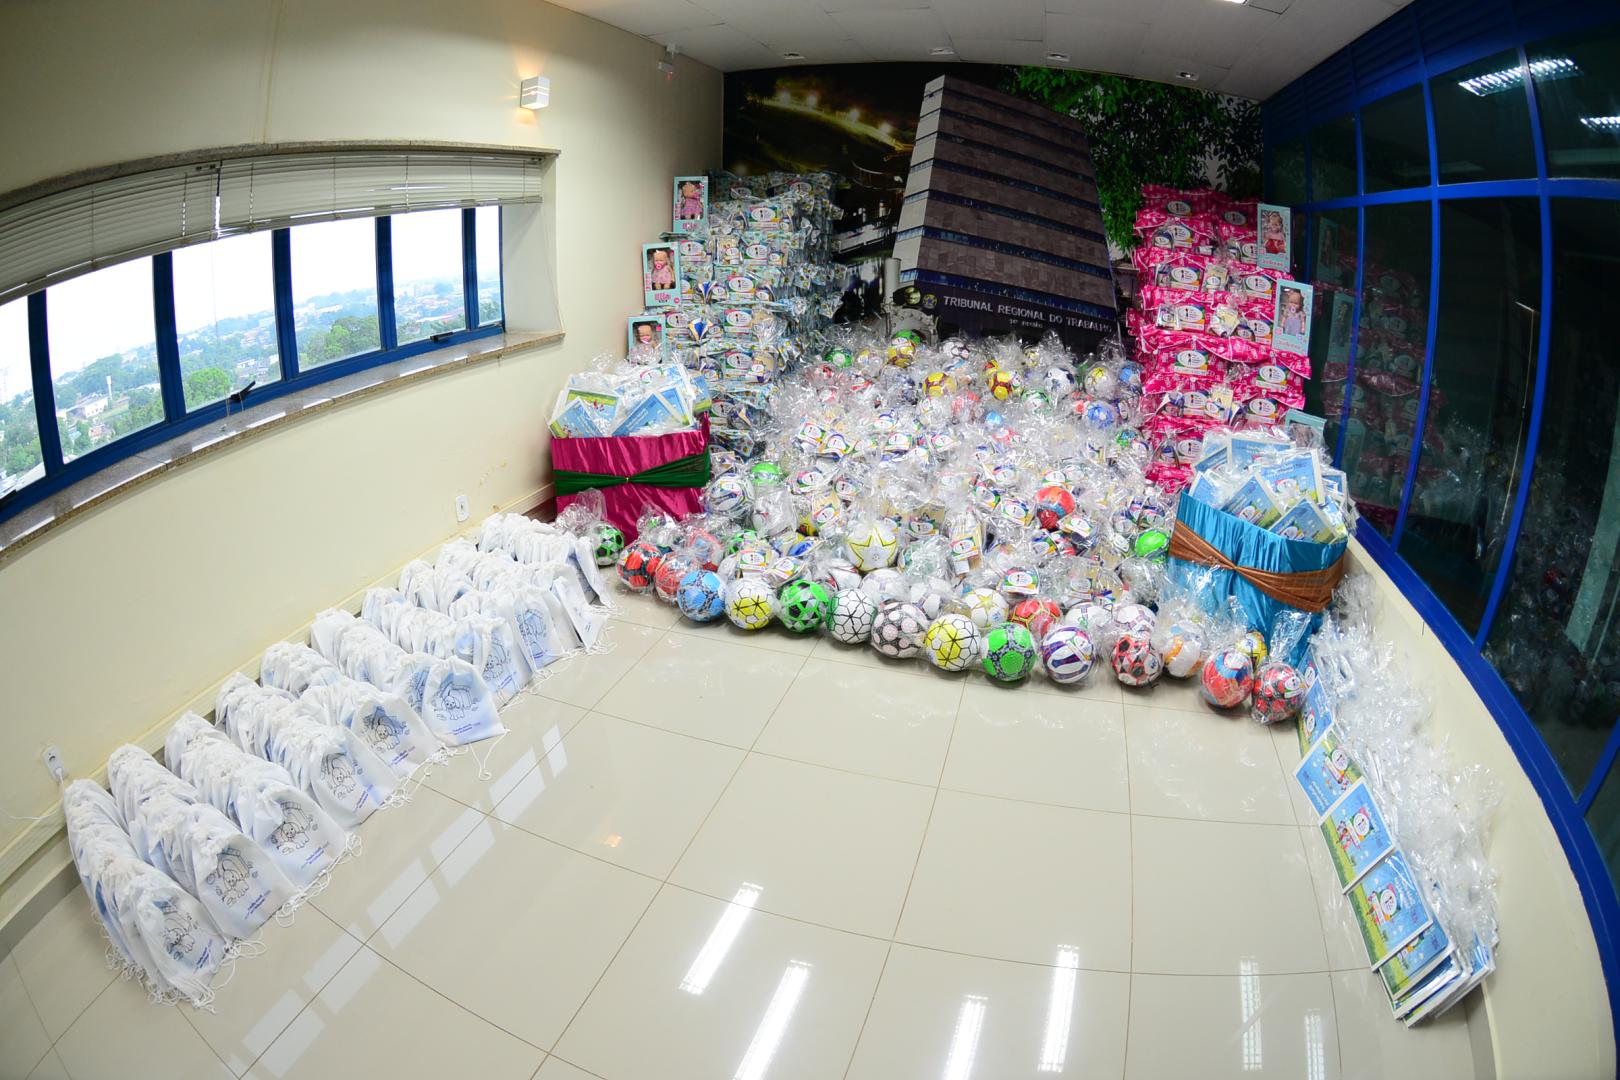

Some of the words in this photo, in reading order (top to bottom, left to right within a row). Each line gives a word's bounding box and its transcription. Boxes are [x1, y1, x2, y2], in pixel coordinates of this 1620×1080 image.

[944, 296, 993, 312] TRIBUNAL
[997, 304, 1045, 320] REGIONAL
[1049, 314, 1063, 324] DO
